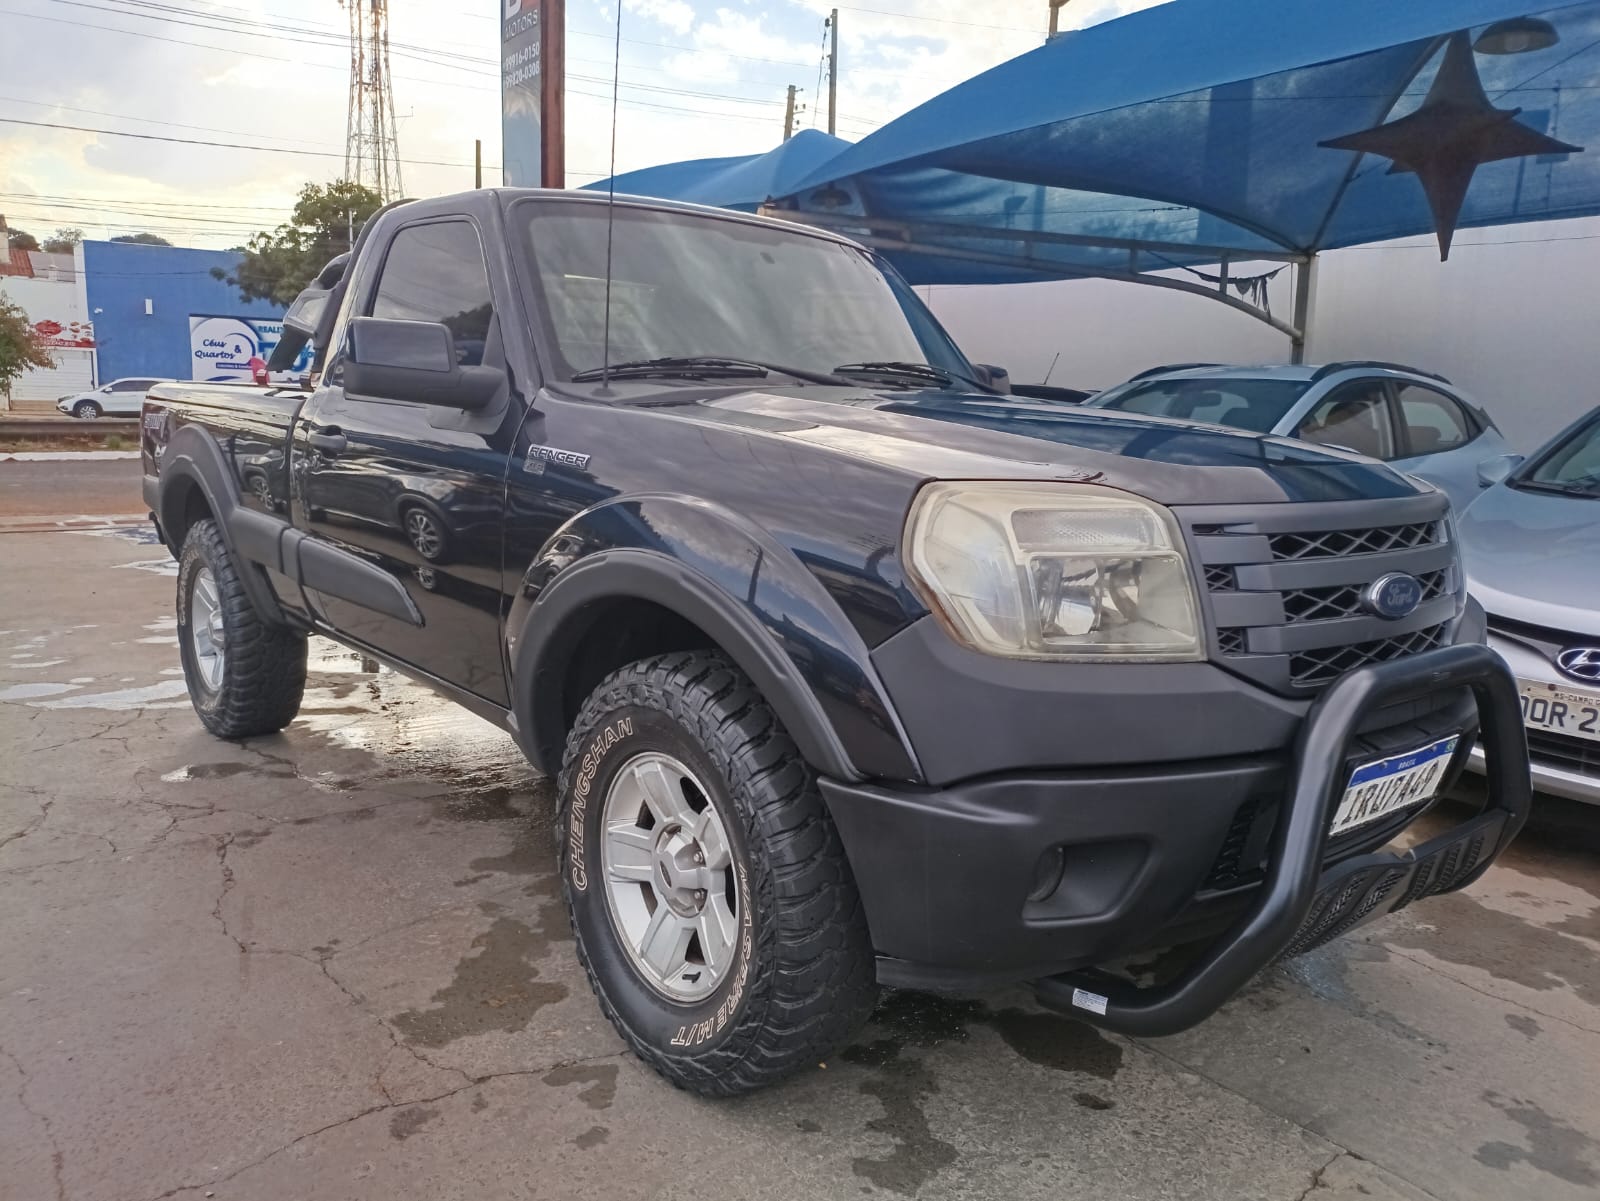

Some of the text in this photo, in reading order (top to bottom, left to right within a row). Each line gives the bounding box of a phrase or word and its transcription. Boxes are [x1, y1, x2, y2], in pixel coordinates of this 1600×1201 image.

[505, 9, 539, 40] MOTORS
[194, 350, 236, 360] Quartos
[528, 444, 590, 470] RANGER
[570, 717, 634, 891] CHENGSHAN
